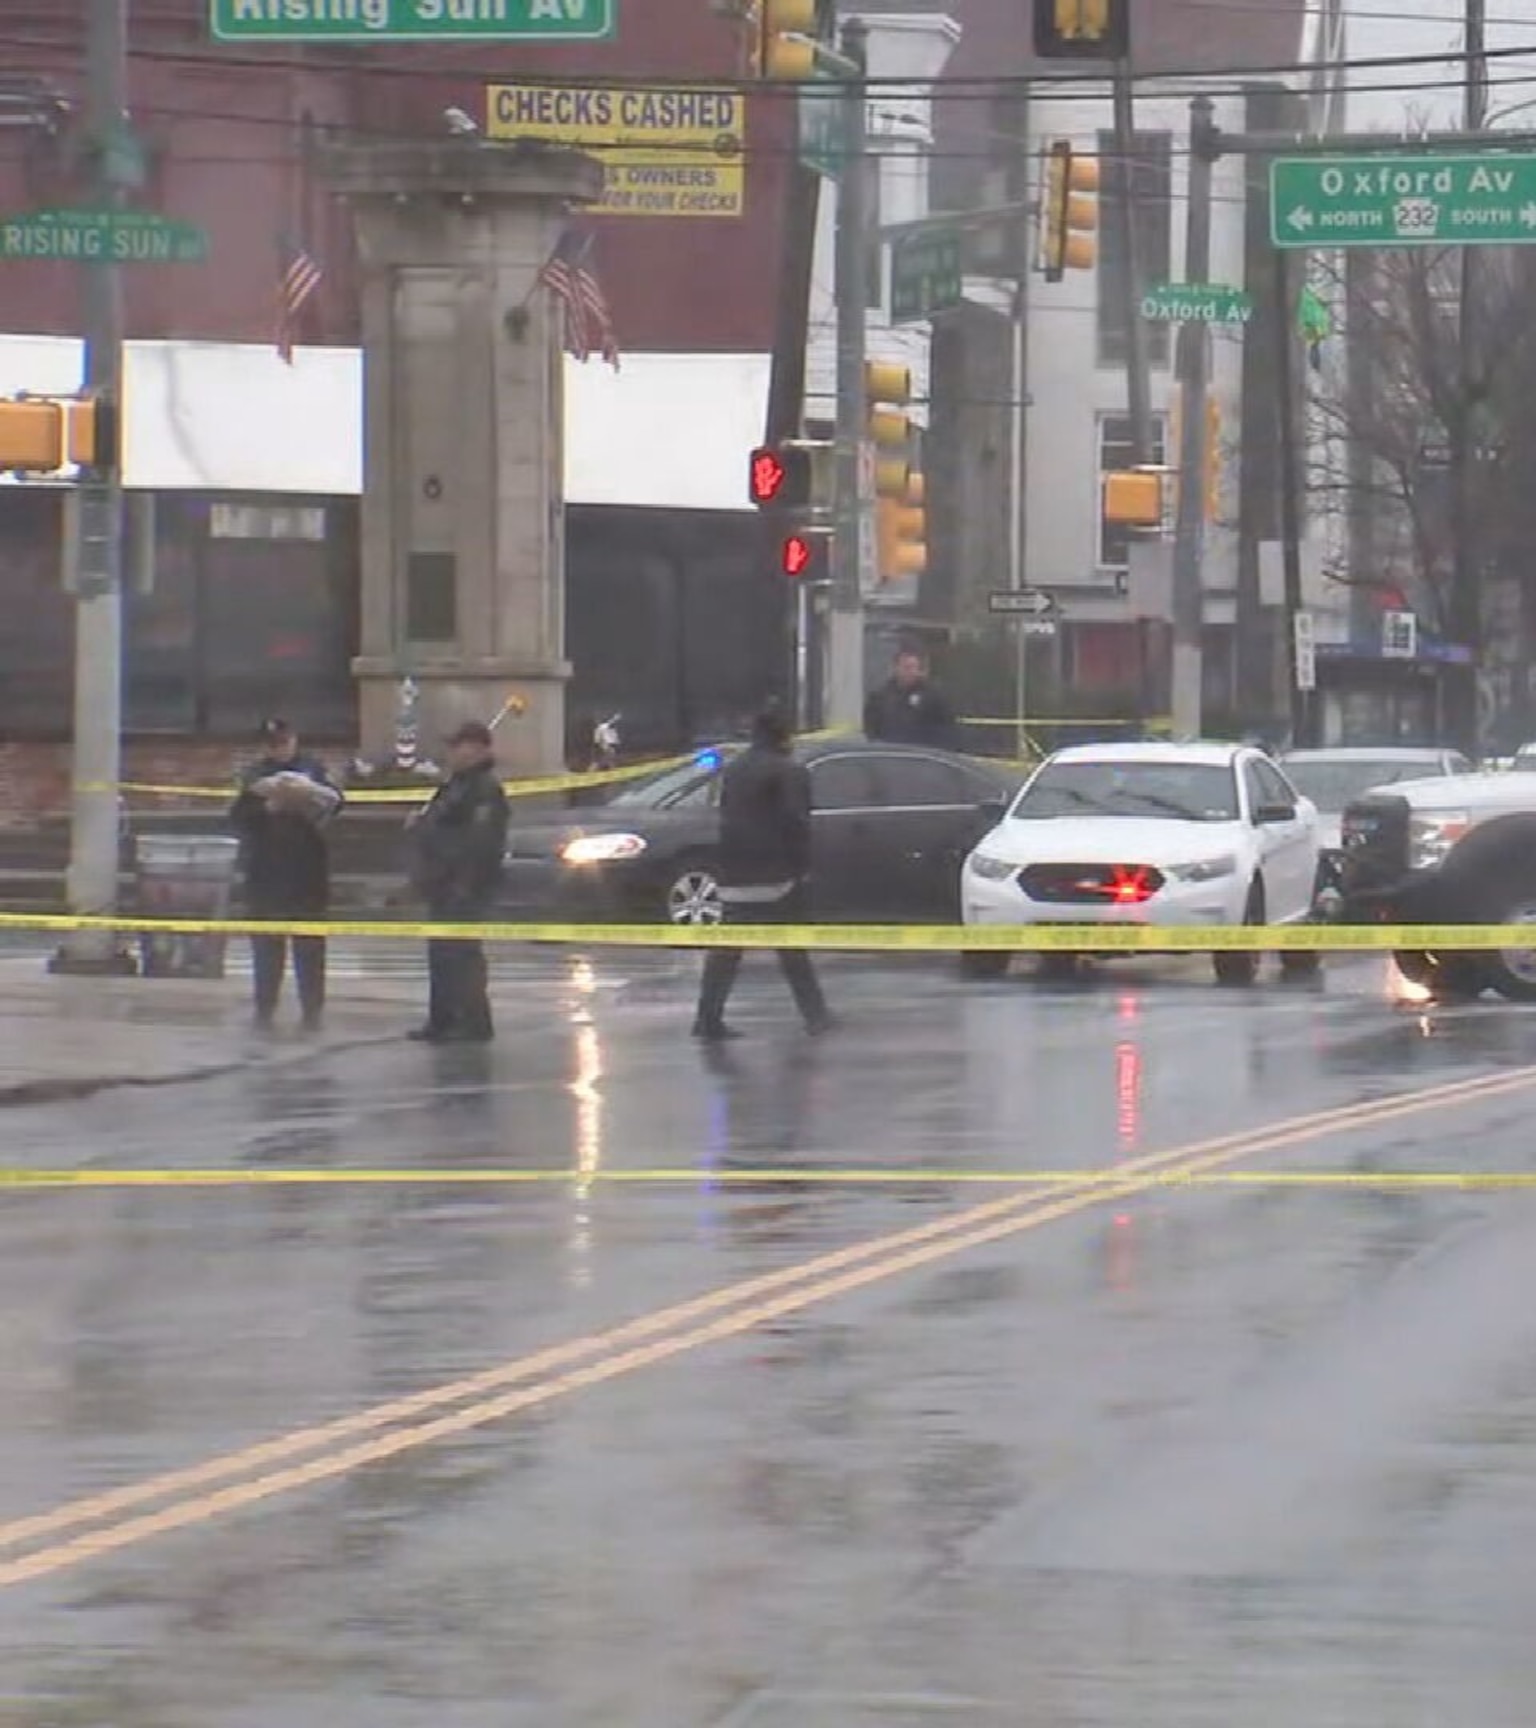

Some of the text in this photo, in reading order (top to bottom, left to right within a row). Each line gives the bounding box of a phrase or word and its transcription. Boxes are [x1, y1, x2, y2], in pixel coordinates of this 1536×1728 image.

[233, 0, 586, 29] Rising Sun Av
[497, 90, 733, 128] CHECKS CASHED
[628, 168, 717, 186] OWNERS
[1320, 166, 1514, 196] Oxford Av
[1320, 206, 1512, 227] NORTH 232 SOUTH
[4, 225, 100, 255] RISING
[114, 229, 171, 258] SUN
[1141, 298, 1253, 321] Oxford Av
